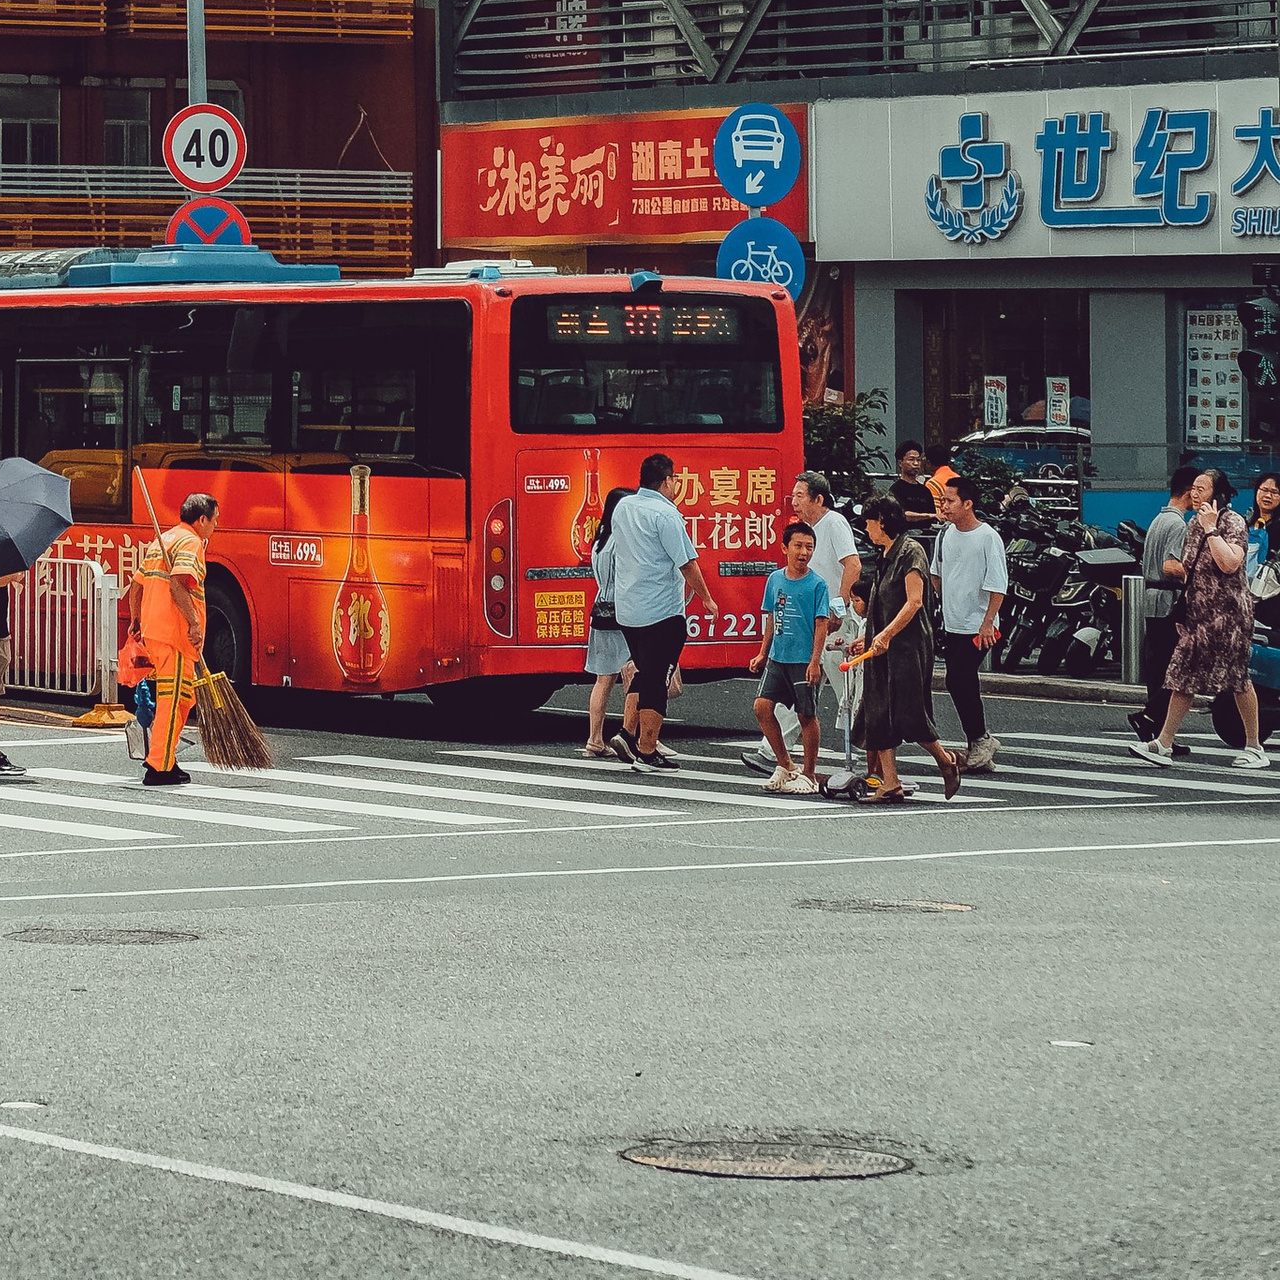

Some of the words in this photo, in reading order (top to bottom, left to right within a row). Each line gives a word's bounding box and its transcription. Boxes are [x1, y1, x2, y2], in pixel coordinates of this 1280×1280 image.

[183, 128, 230, 168] 40
[632, 138, 718, 181] 湖南土
[674, 466, 777, 507] 办宴席
[272, 541, 290, 552] 红十五
[536, 611, 585, 624] 高压危险
[536, 624, 585, 638] 保持车距
